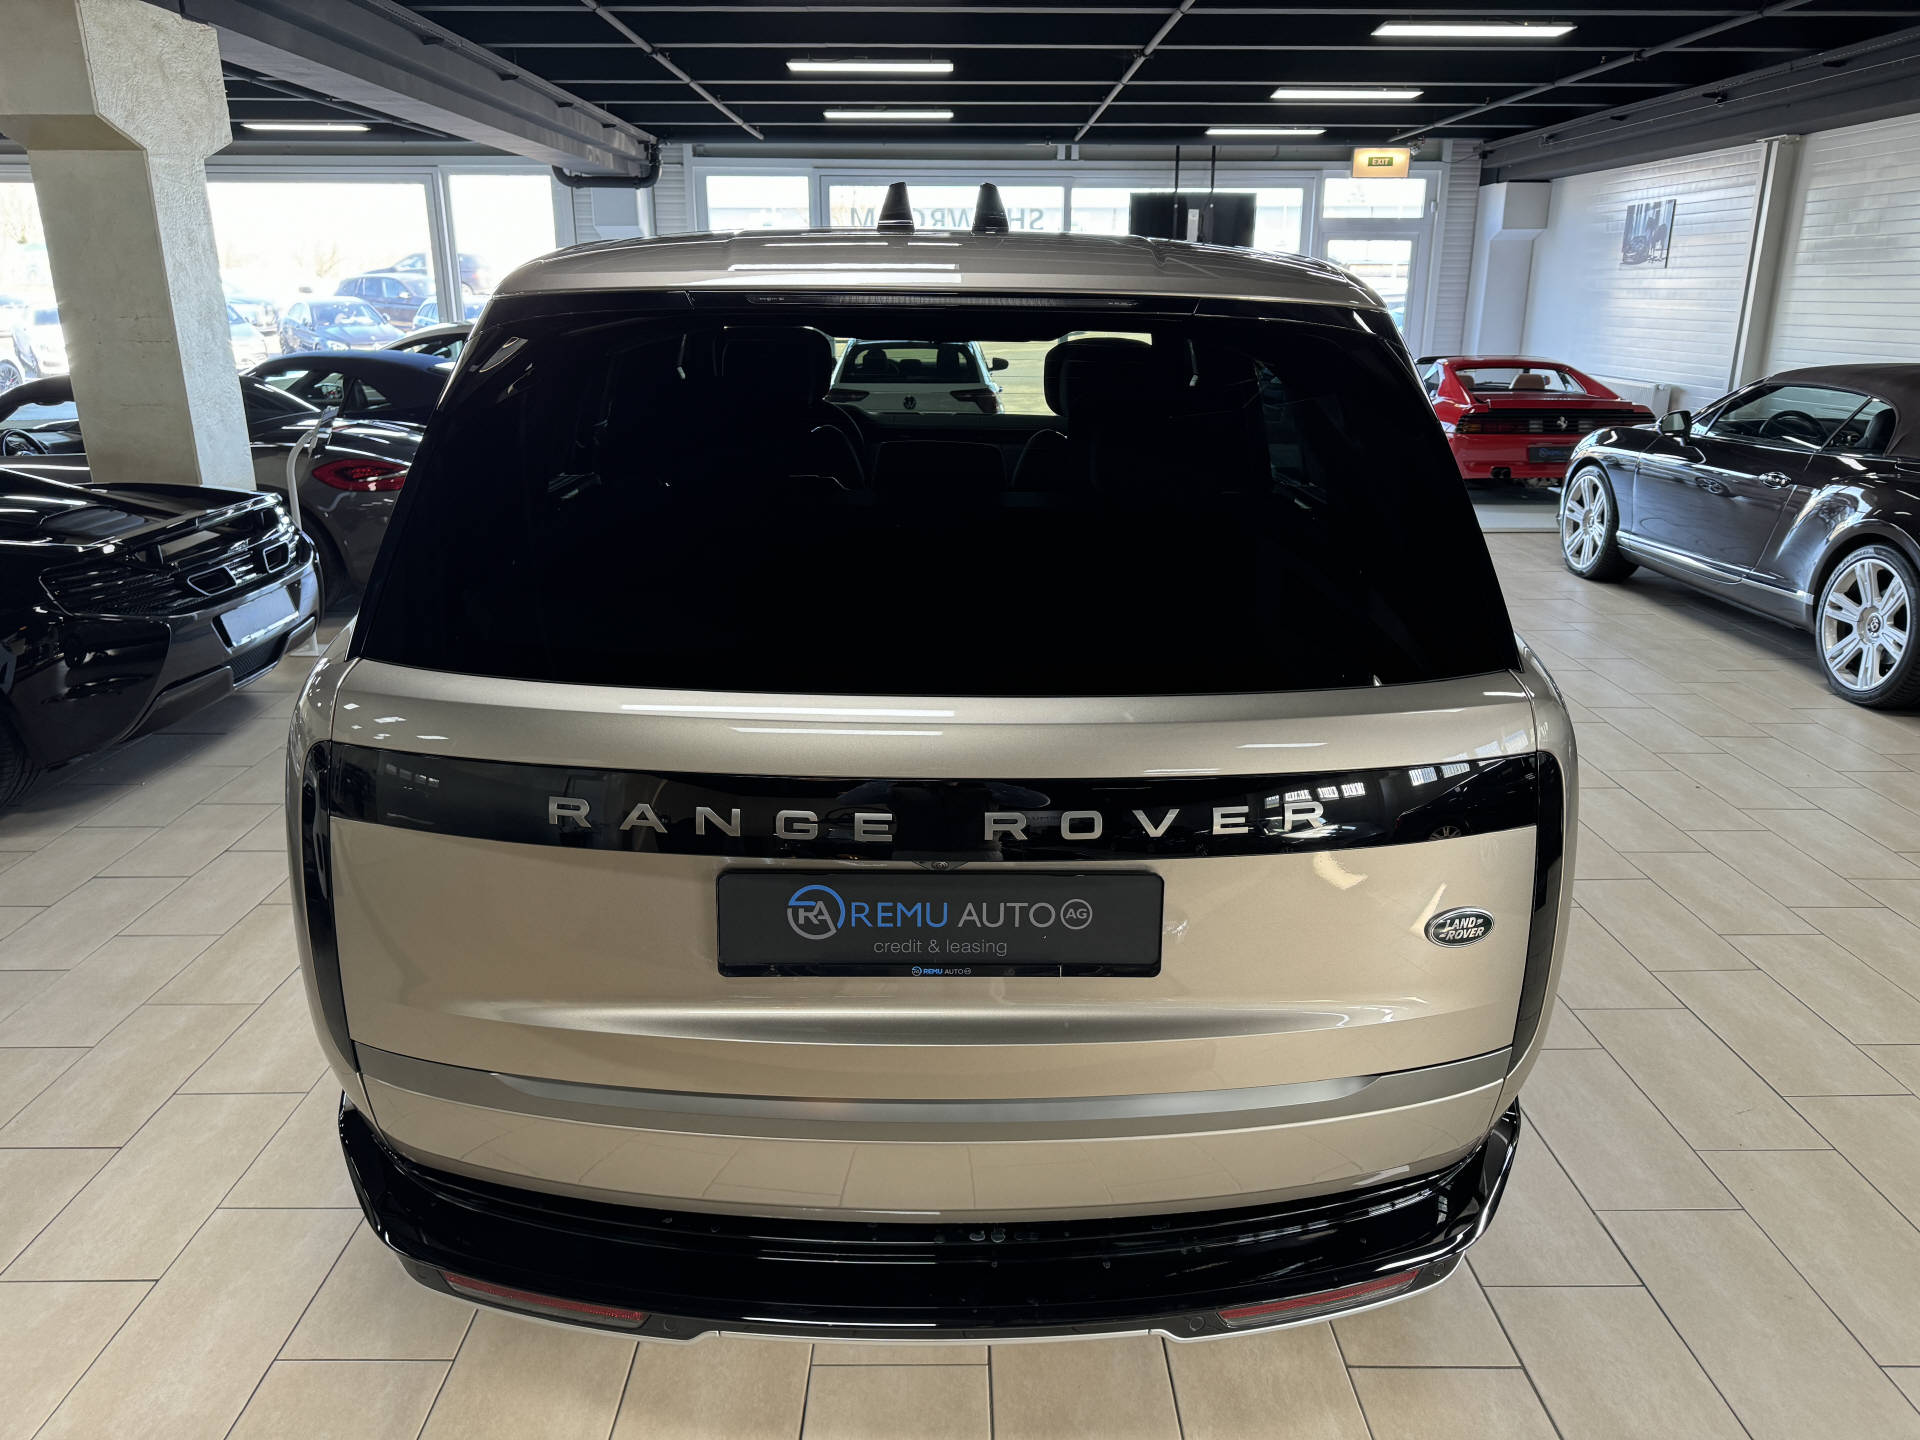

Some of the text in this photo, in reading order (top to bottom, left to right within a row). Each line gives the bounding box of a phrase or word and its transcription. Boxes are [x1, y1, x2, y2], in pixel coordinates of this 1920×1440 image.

[548, 796, 1324, 842] RANGE ROVER
[851, 902, 948, 928] REMU
[957, 902, 1056, 928] AUTO
[1065, 907, 1088, 920] AG
[1443, 917, 1476, 931] LAND
[1446, 927, 1484, 941] ROVER
[873, 938, 1007, 957] credit & leasing
